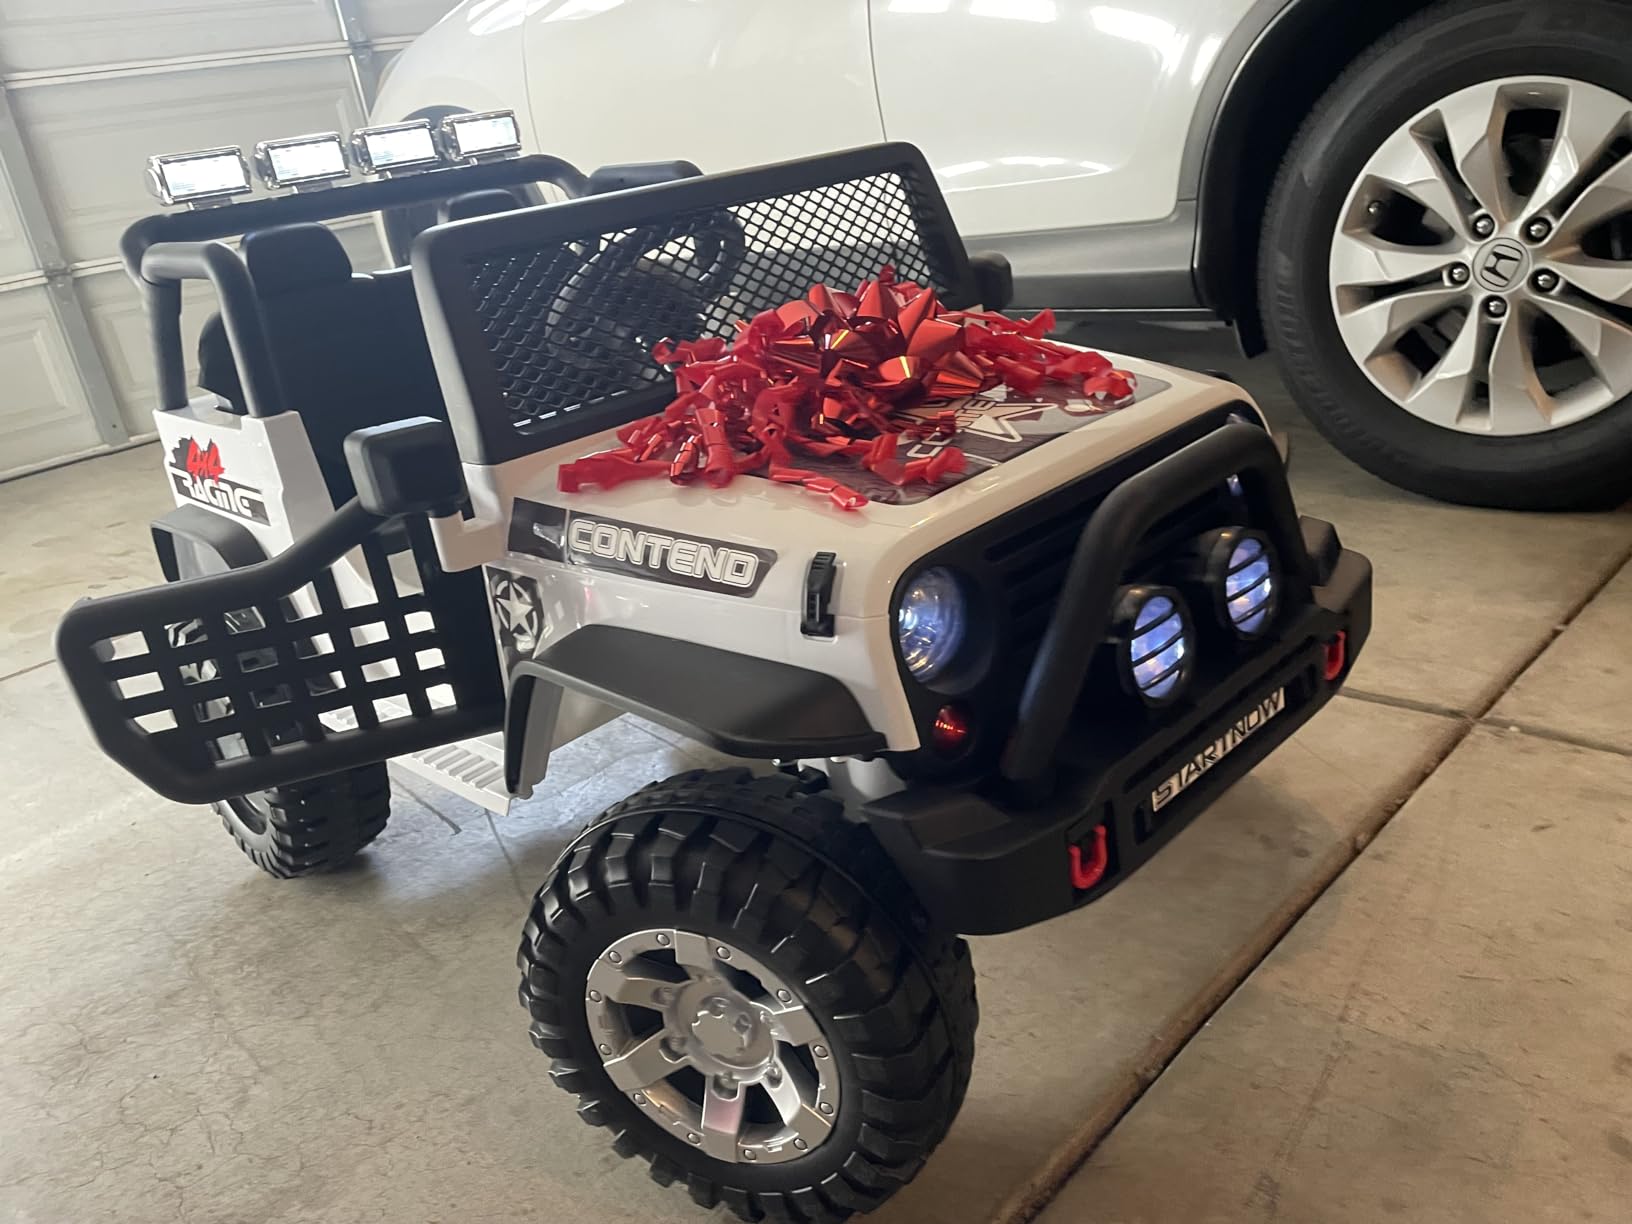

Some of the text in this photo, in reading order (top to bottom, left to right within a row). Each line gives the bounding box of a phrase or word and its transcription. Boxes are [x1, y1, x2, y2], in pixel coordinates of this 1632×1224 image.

[169, 466, 263, 518] RACING
[568, 518, 759, 588] CONTEND
[1151, 686, 1287, 812] STARTNOW
